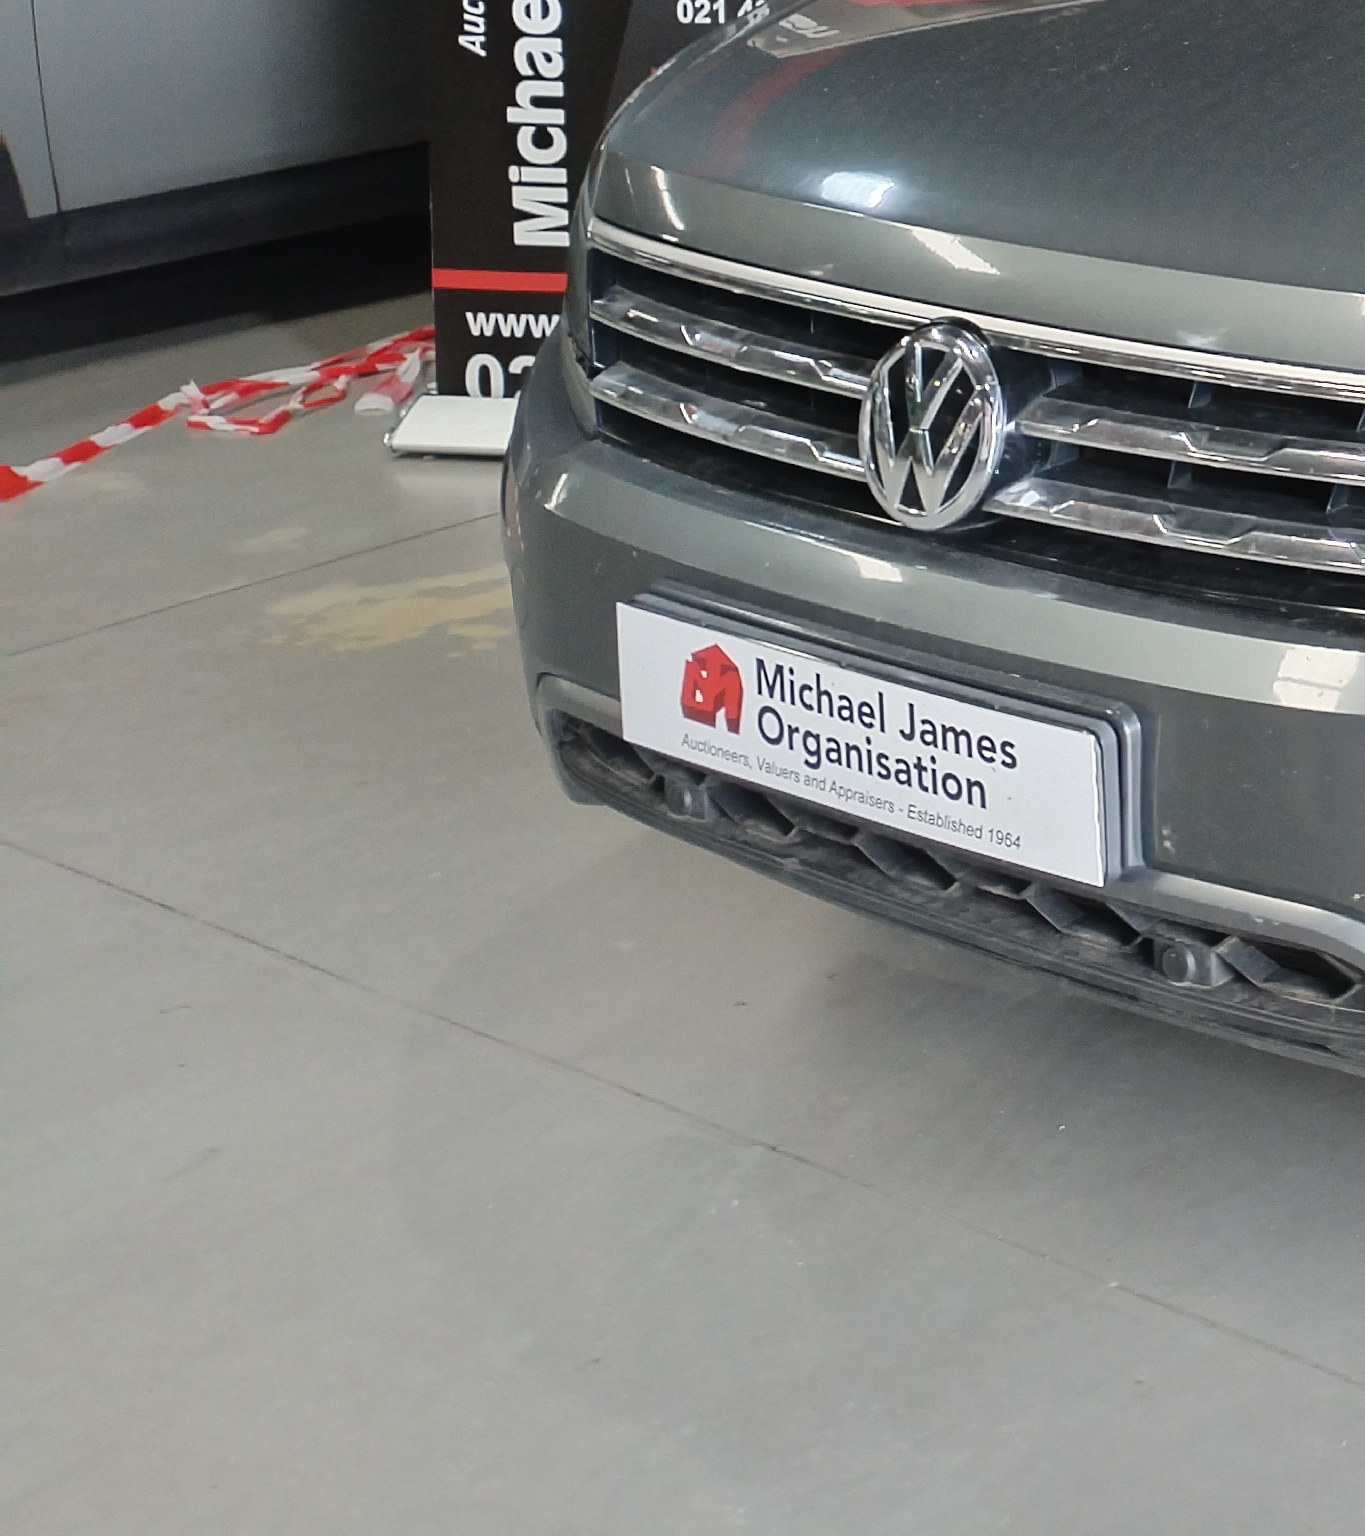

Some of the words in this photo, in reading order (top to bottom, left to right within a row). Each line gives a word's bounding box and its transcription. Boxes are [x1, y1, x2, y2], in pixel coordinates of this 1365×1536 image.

[755, 657, 887, 734] Michael
[899, 702, 1019, 770] James
[757, 705, 988, 810] Organisation
[681, 733, 753, 771] Auctioneers,
[756, 755, 801, 786] Valuers
[803, 771, 827, 793] and
[829, 778, 896, 815] Appraisers
[907, 804, 984, 841] Established
[987, 827, 1022, 851] 1964
